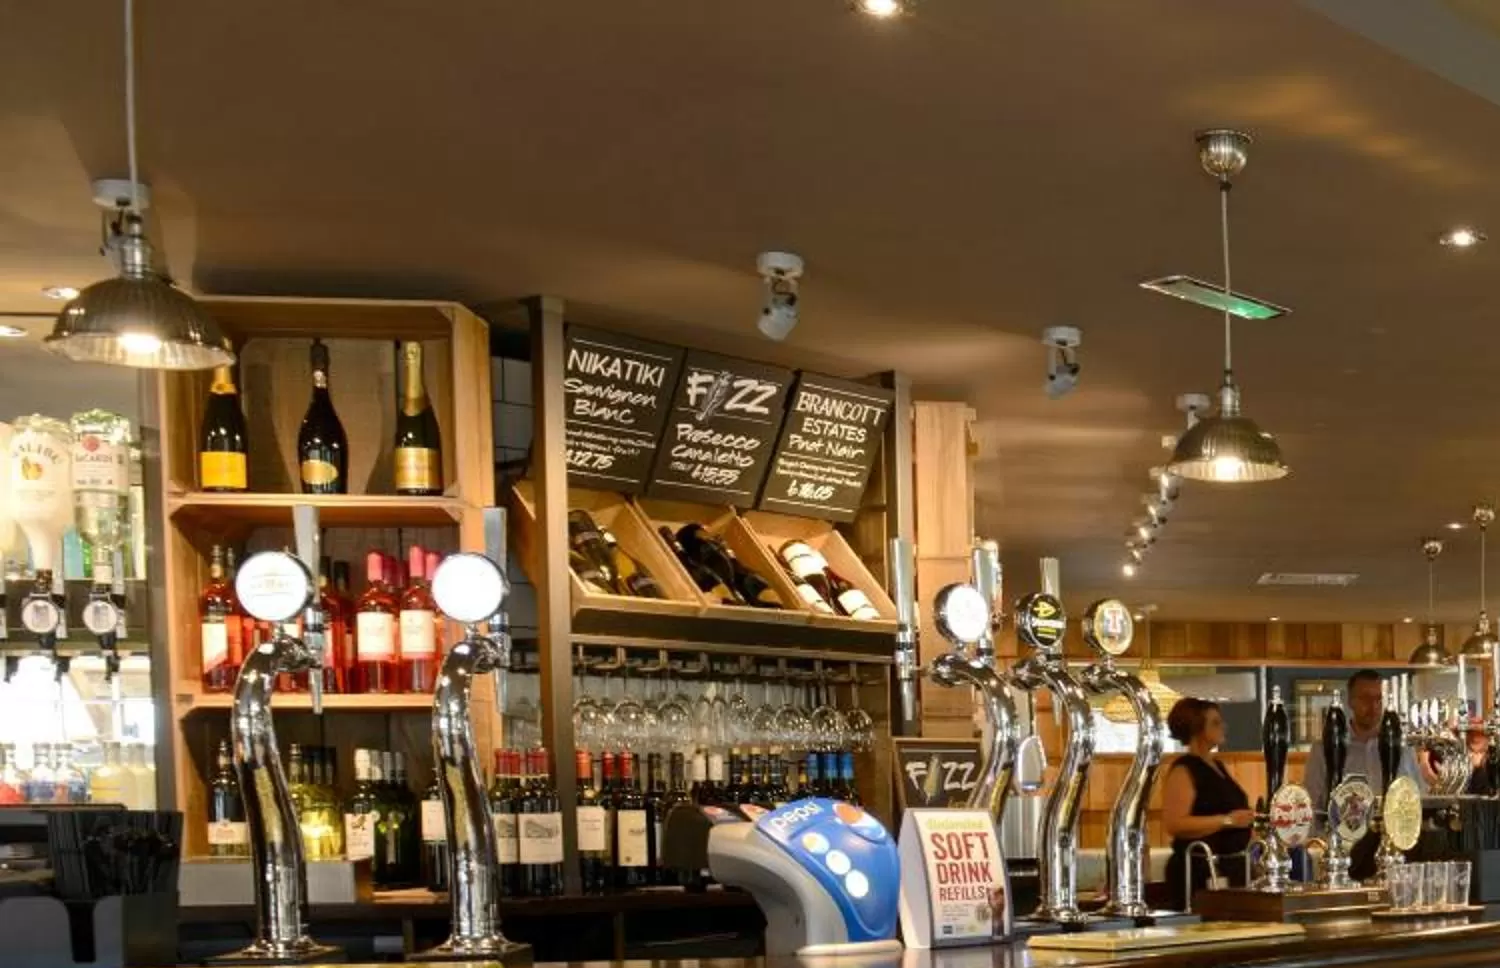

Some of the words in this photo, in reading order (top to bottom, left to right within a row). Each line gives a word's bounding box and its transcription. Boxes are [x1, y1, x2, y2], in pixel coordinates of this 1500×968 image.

[567, 348, 665, 387] NIKATIKI
[796, 391, 886, 425] BRANCOTT
[676, 423, 760, 450] Prosecco
[801, 417, 867, 443] ESTATES
[930, 832, 989, 861] SOFT
[936, 862, 993, 885] DRINK
